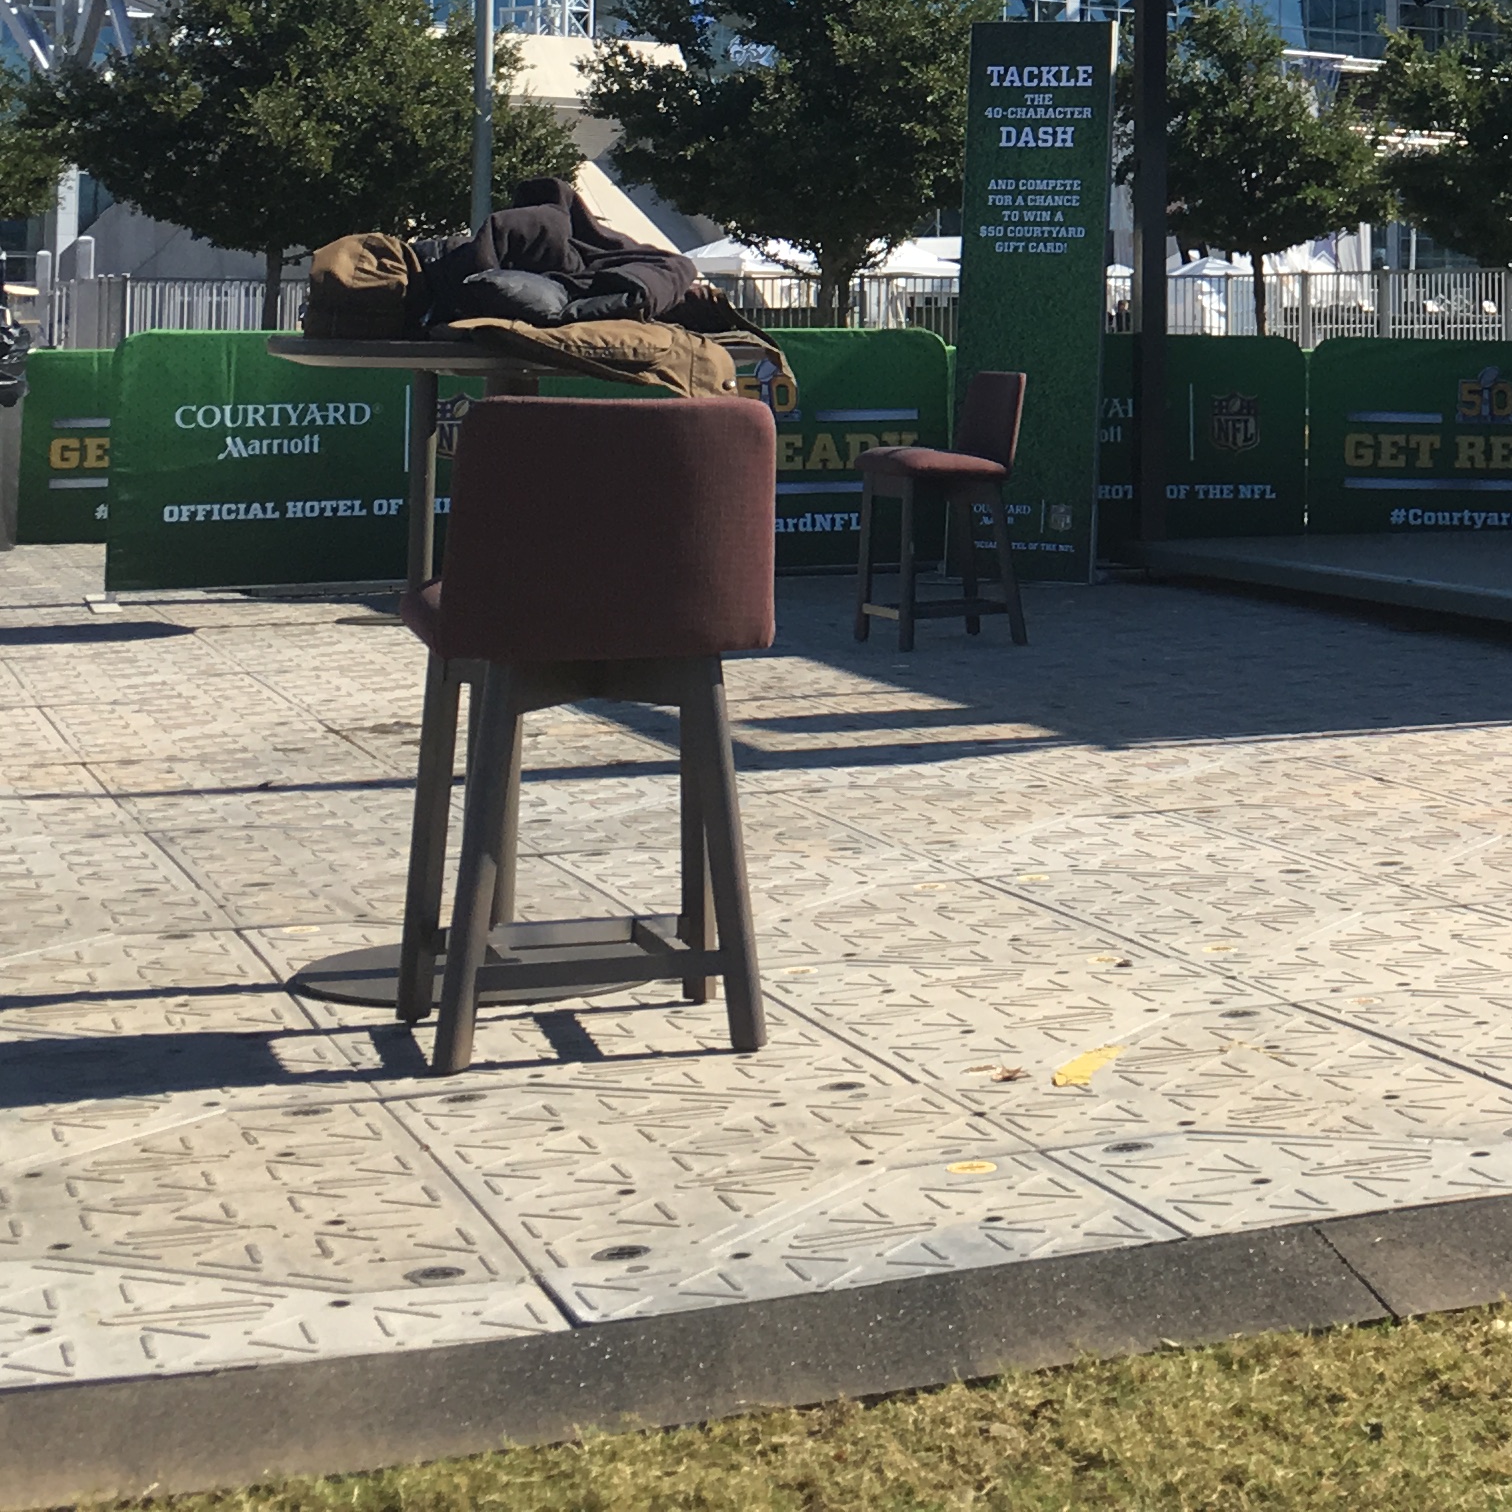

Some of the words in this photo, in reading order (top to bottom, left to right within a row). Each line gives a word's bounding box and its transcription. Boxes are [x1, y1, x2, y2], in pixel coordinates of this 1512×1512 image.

[987, 65, 1093, 87] TACKLE
[1024, 94, 1053, 105] THE
[984, 107, 1093, 119] 40-CHARACTER
[999, 126, 1075, 148] DASH
[988, 180, 1015, 190] AND
[1018, 179, 1081, 191] COMPETE
[987, 195, 1013, 206] FOR
[1015, 195, 1025, 206] A
[1027, 195, 1080, 206] CHANCE
[1002, 211, 1019, 222] TO
[1023, 211, 1051, 222] WIN
[1054, 211, 1064, 222] A
[979, 226, 1004, 238] $50
[1007, 227, 1085, 238] COURTYARD
[995, 242, 1025, 252] GIFT
[1028, 242, 1068, 253] CARD!
[174, 402, 371, 430] COURTYARD
[49, 437, 110, 469] GE
[217, 433, 320, 460] Marriott
[1344, 434, 1440, 468] GET
[1098, 485, 1133, 499] HOT
[1166, 484, 1190, 499] OF
[1195, 484, 1234, 499] THE
[1238, 484, 1276, 500] NFL
[163, 500, 280, 523] OFFICIAL
[286, 499, 367, 519] HOTEL
[373, 498, 403, 516] OF
[774, 512, 861, 533] ardNFL
